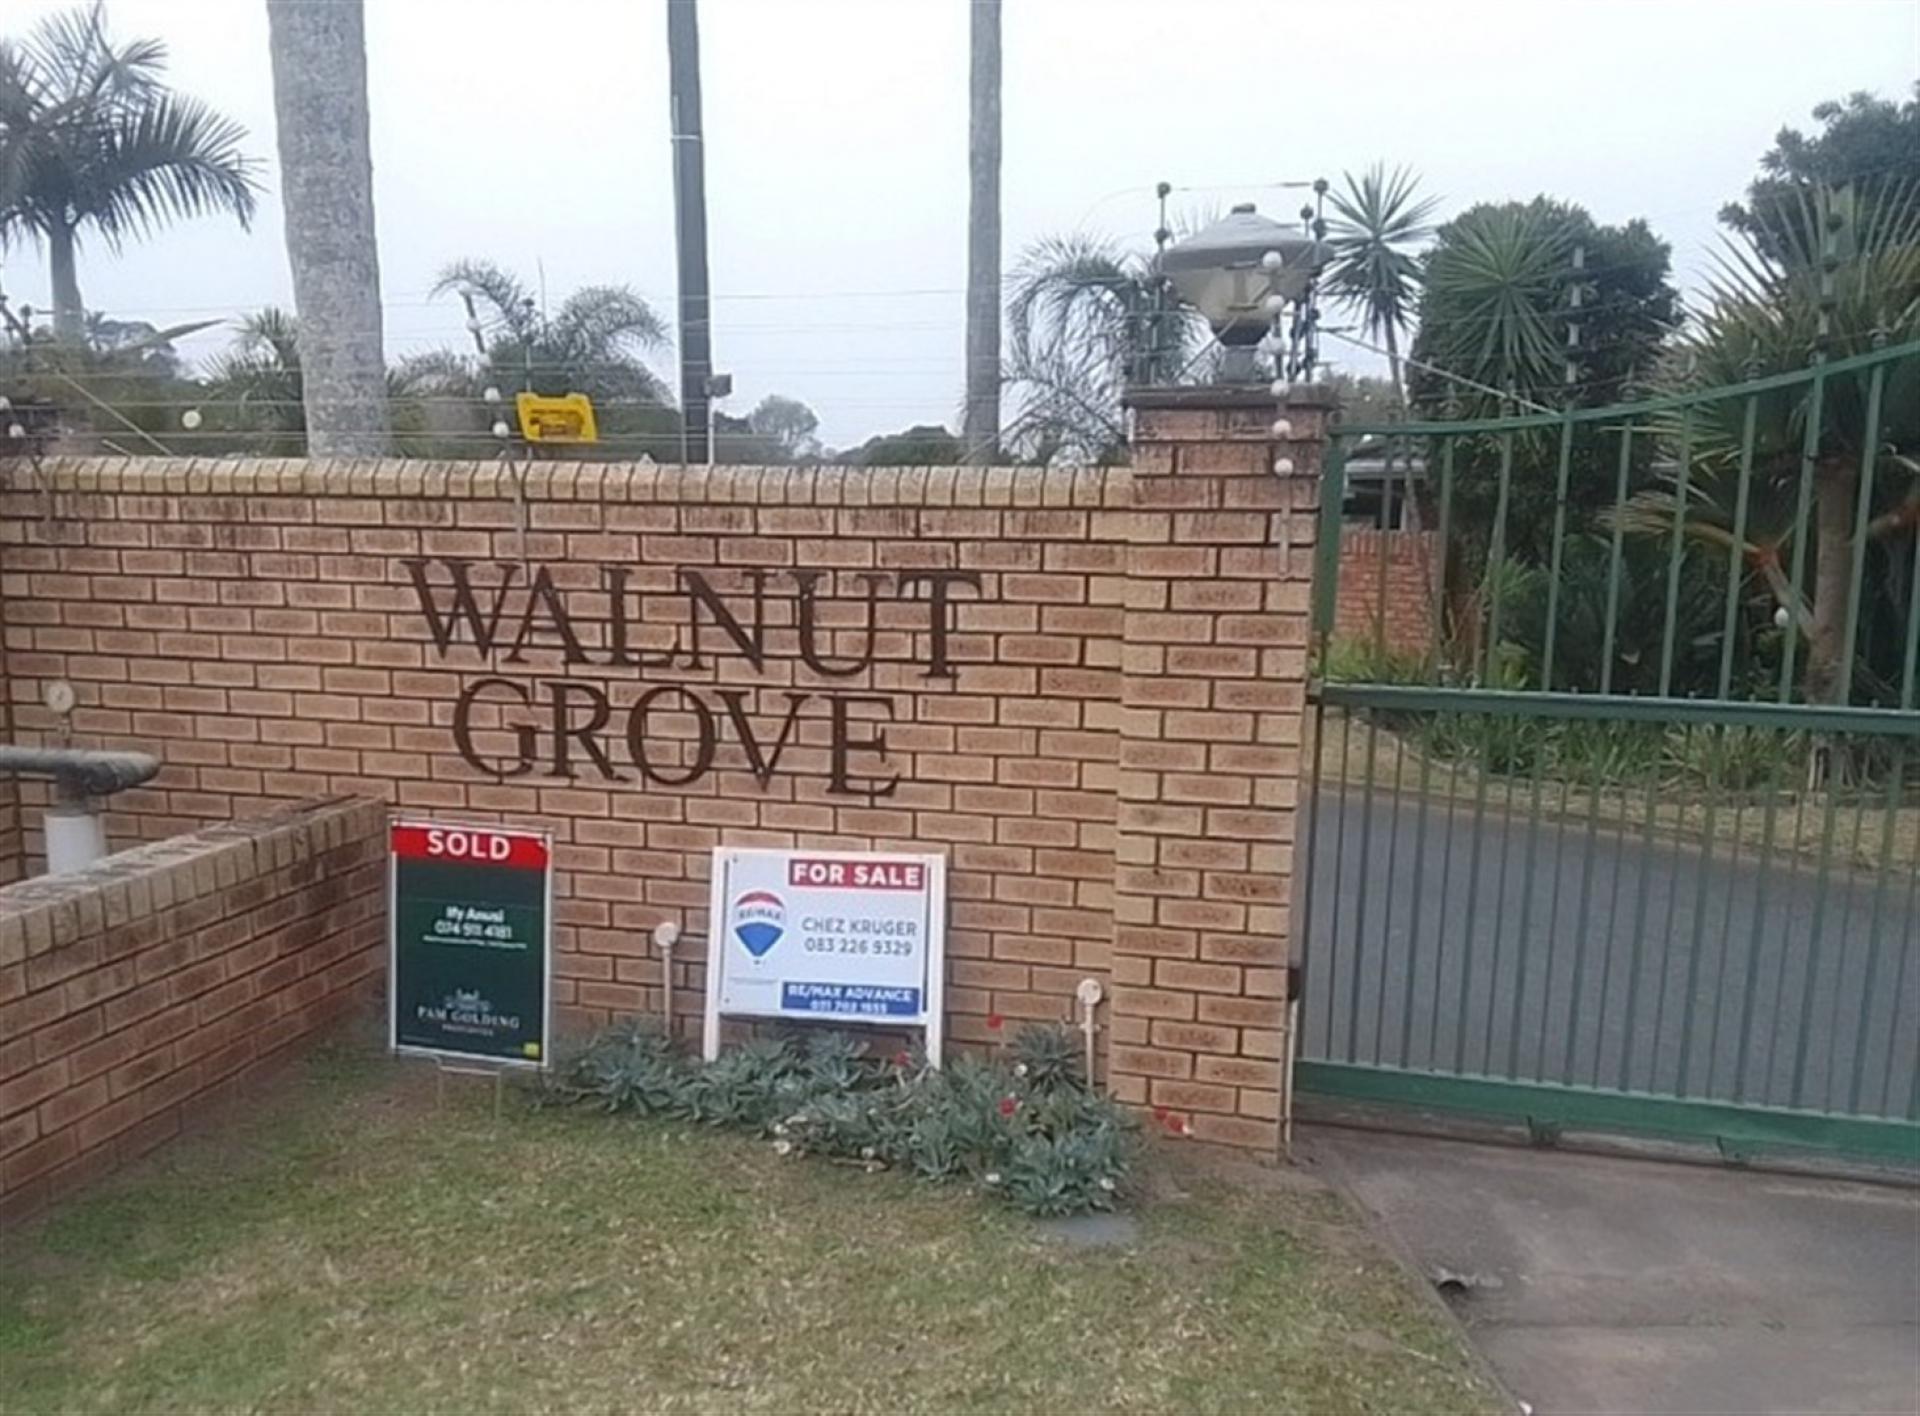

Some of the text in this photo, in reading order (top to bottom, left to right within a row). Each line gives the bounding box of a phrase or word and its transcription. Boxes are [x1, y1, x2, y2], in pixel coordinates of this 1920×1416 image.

[402, 556, 983, 680] WALNUT
[452, 677, 902, 798] GROVE
[427, 830, 510, 861] SOLD
[793, 862, 920, 886] FOR SALE
[802, 916, 917, 937] CHEZ KRUGER
[787, 984, 913, 1003] RE/MAX ADVANCE
[418, 1005, 447, 1021] PAM
[450, 1010, 520, 1030] GOLDING
